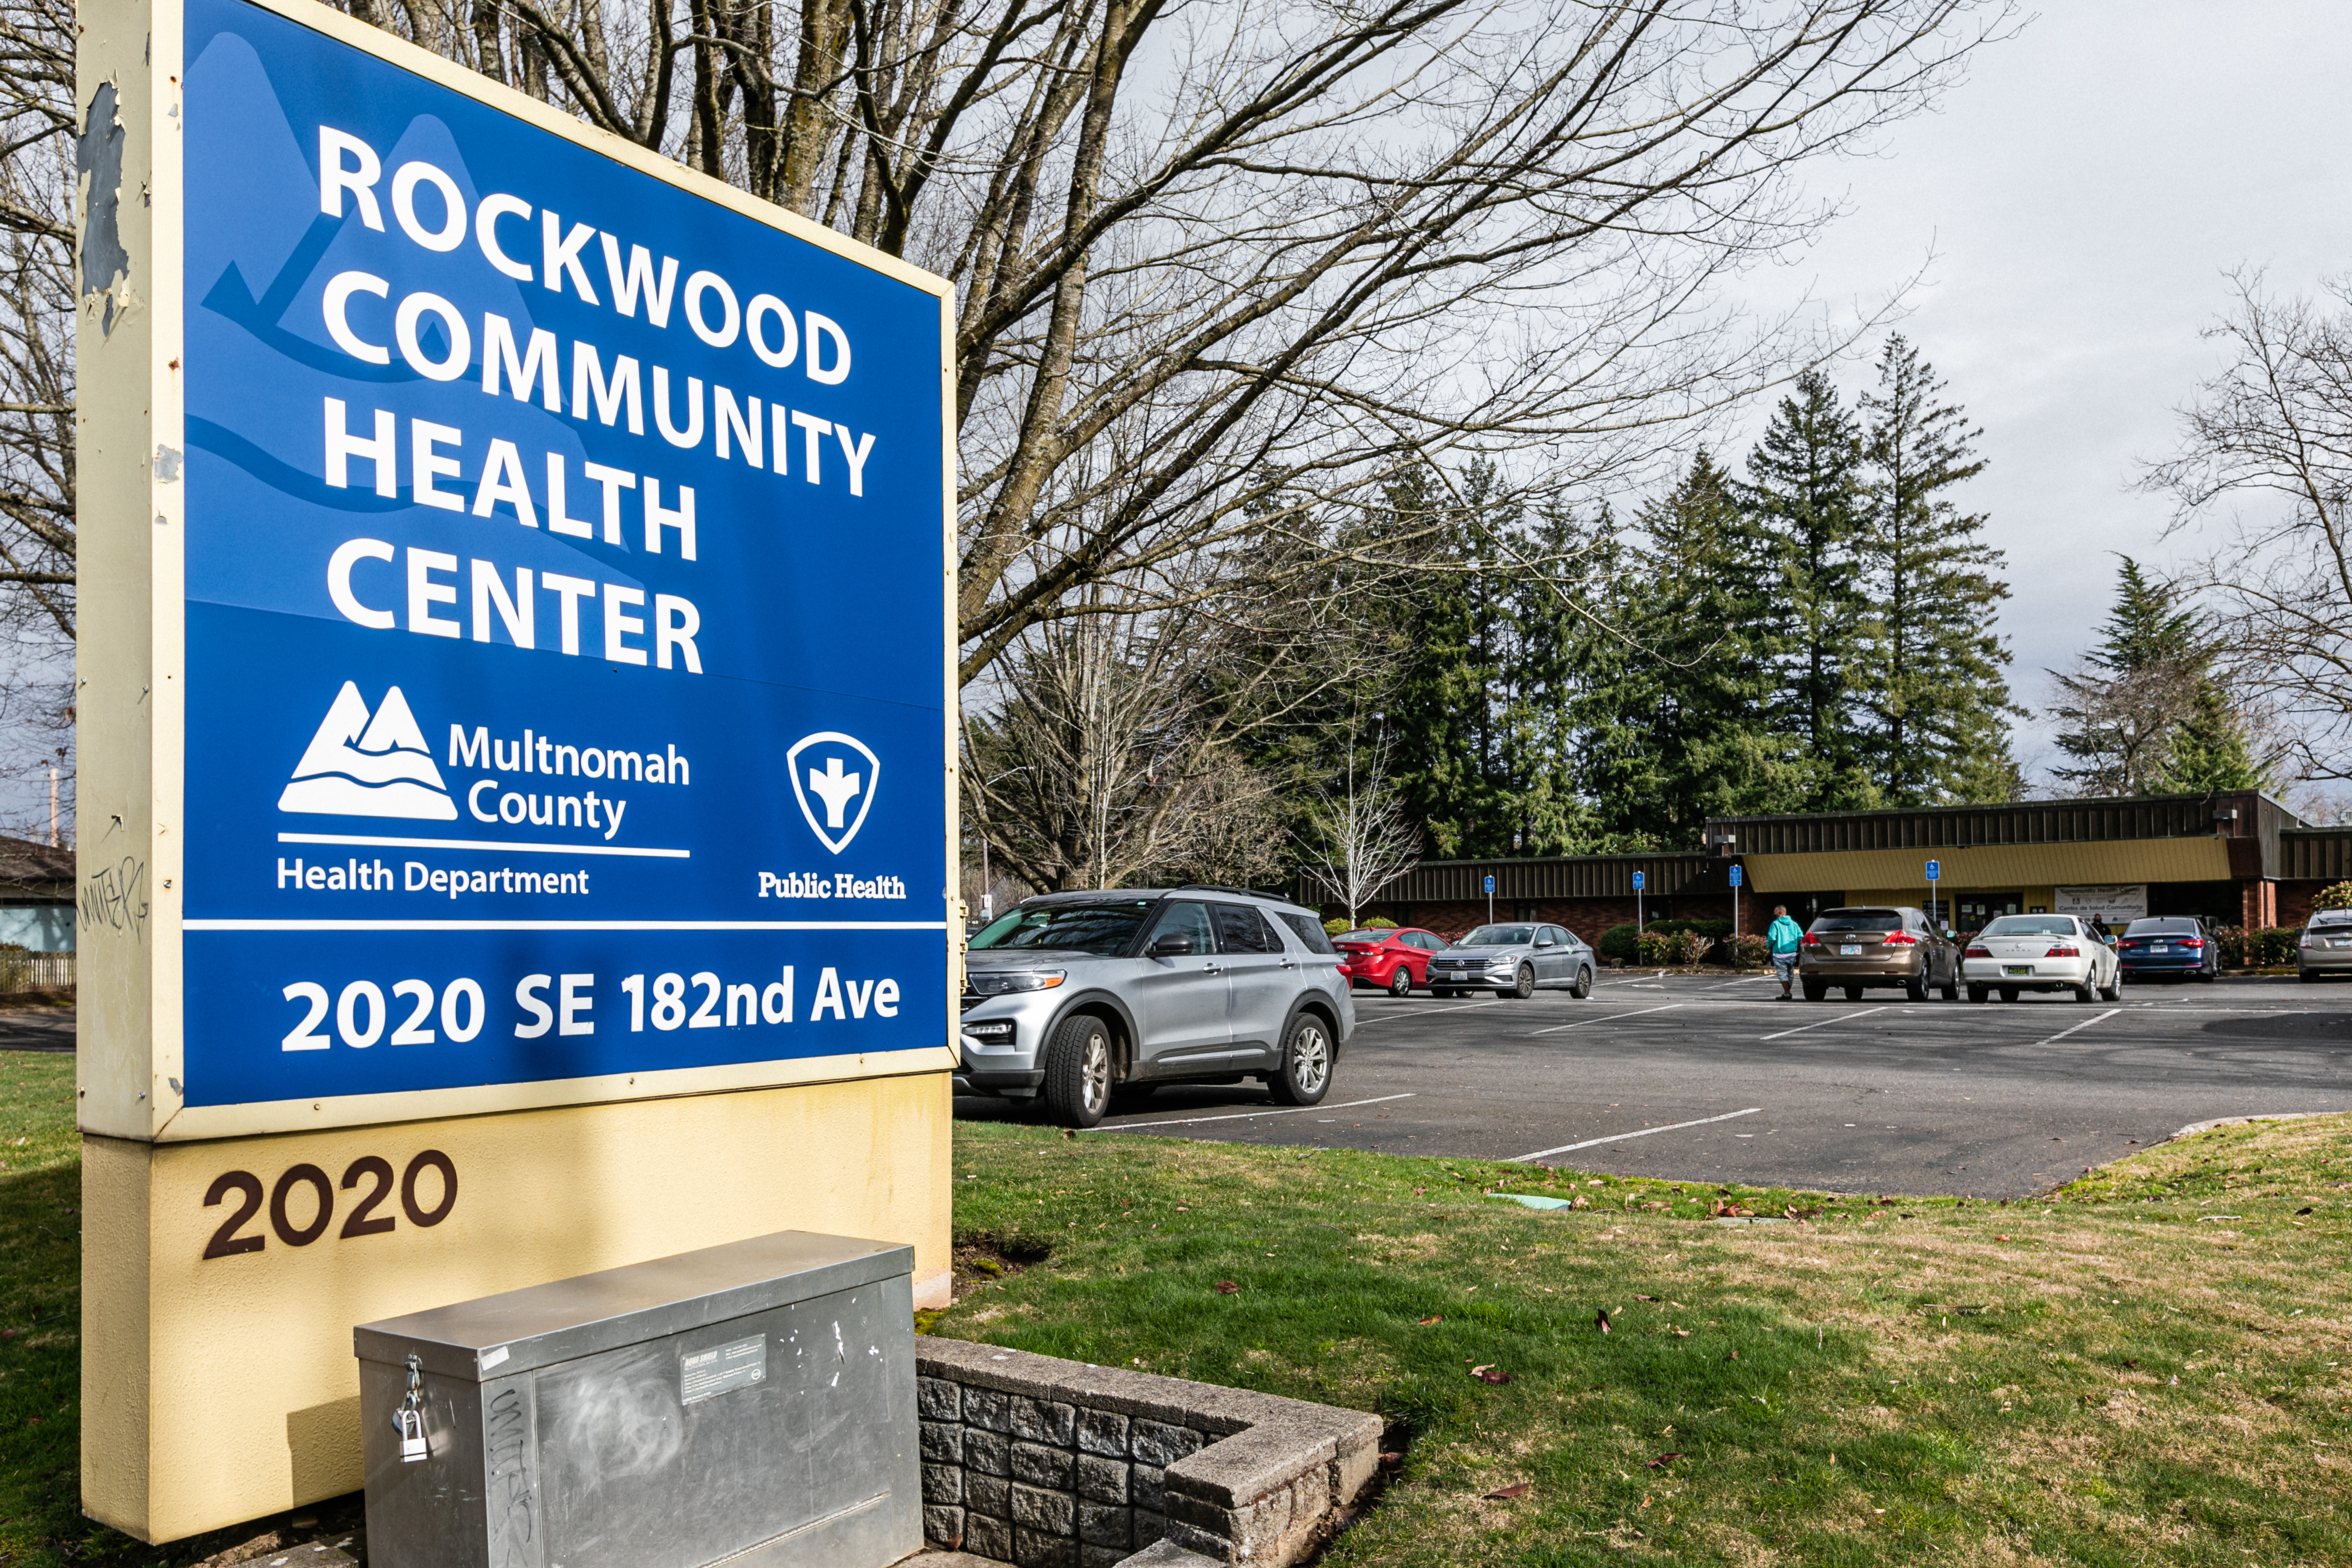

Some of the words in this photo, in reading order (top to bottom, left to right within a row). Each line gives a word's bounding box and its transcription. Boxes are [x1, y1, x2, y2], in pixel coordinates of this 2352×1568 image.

[319, 125, 851, 385] ROCKWOOD
[322, 271, 876, 497] COMMUNITY
[324, 396, 697, 562] HEALTH
[327, 538, 703, 674] CENTER
[449, 724, 689, 785] Multnomah
[468, 779, 627, 841] County
[277, 858, 393, 891] Health
[405, 862, 589, 900] Department
[758, 872, 831, 899] Public
[834, 873, 906, 900] Health
[281, 978, 485, 1052] 2020
[514, 973, 594, 1039] SE
[621, 965, 794, 1032] 182nd
[810, 967, 900, 1021] Ave
[202, 1149, 458, 1250] 2020
[684, 1356, 699, 1367] AQUA
[699, 1351, 717, 1362] SHIELD
